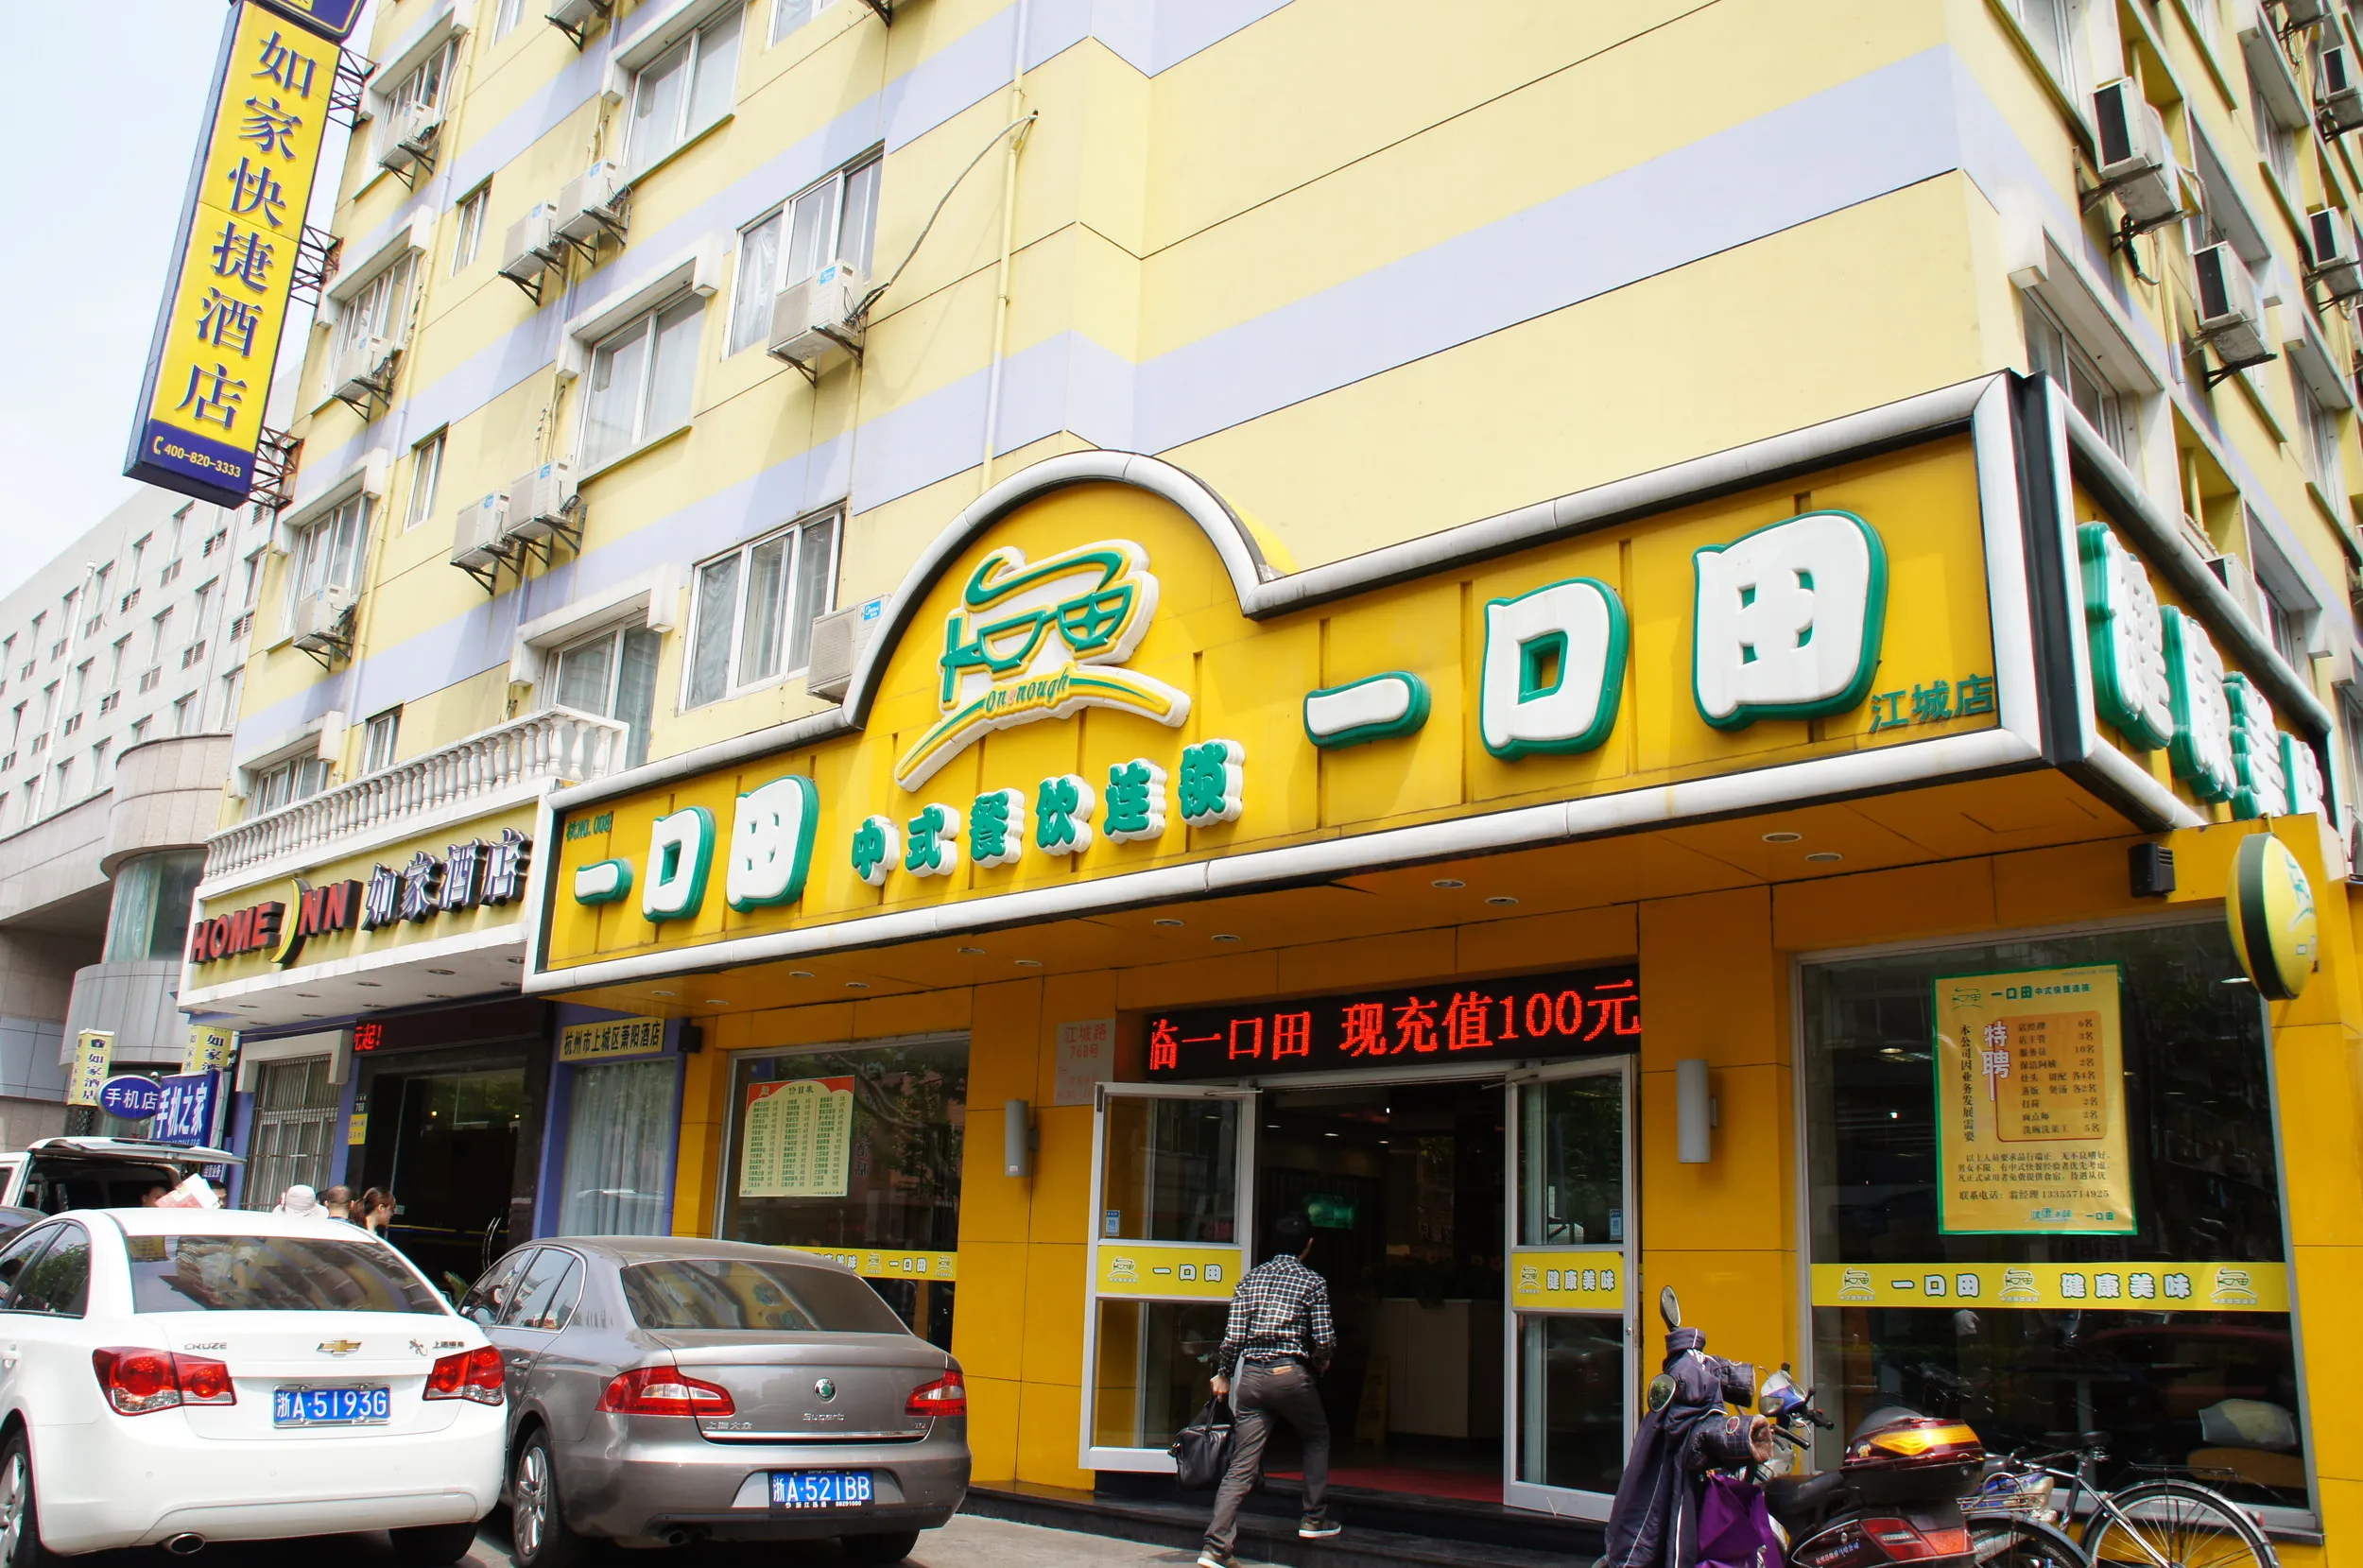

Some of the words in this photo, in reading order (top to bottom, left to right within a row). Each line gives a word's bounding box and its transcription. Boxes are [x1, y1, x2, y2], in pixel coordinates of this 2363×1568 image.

[175, 29, 317, 430] 如家快捷酒店
[164, 443, 242, 478] 400-820-3333
[1303, 508, 1889, 762] 一口田
[1870, 673, 1995, 733] 江城店
[851, 739, 1246, 887] 中式餐饮连锁
[574, 775, 819, 922] 一口田
[361, 827, 533, 932] 如家酒店
[190, 901, 286, 965] HOME
[1338, 979, 1642, 1058] 现充值100元
[1991, 985, 2034, 1000] 一口田
[1960, 1024, 1975, 1142] 本公司因业务发展需要
[1982, 1020, 2010, 1090] 特聘
[106, 1088, 159, 1111] 手机店
[156, 1081, 208, 1139] 手机之家
[888, 1257, 927, 1274] 一口田
[1152, 1264, 1223, 1283] 一口田
[1545, 1268, 1616, 1292] 健康美味
[1890, 1272, 1980, 1299] 一口田
[2061, 1272, 2192, 1300] 健康美味
[183, 1342, 228, 1352] CRUZE
